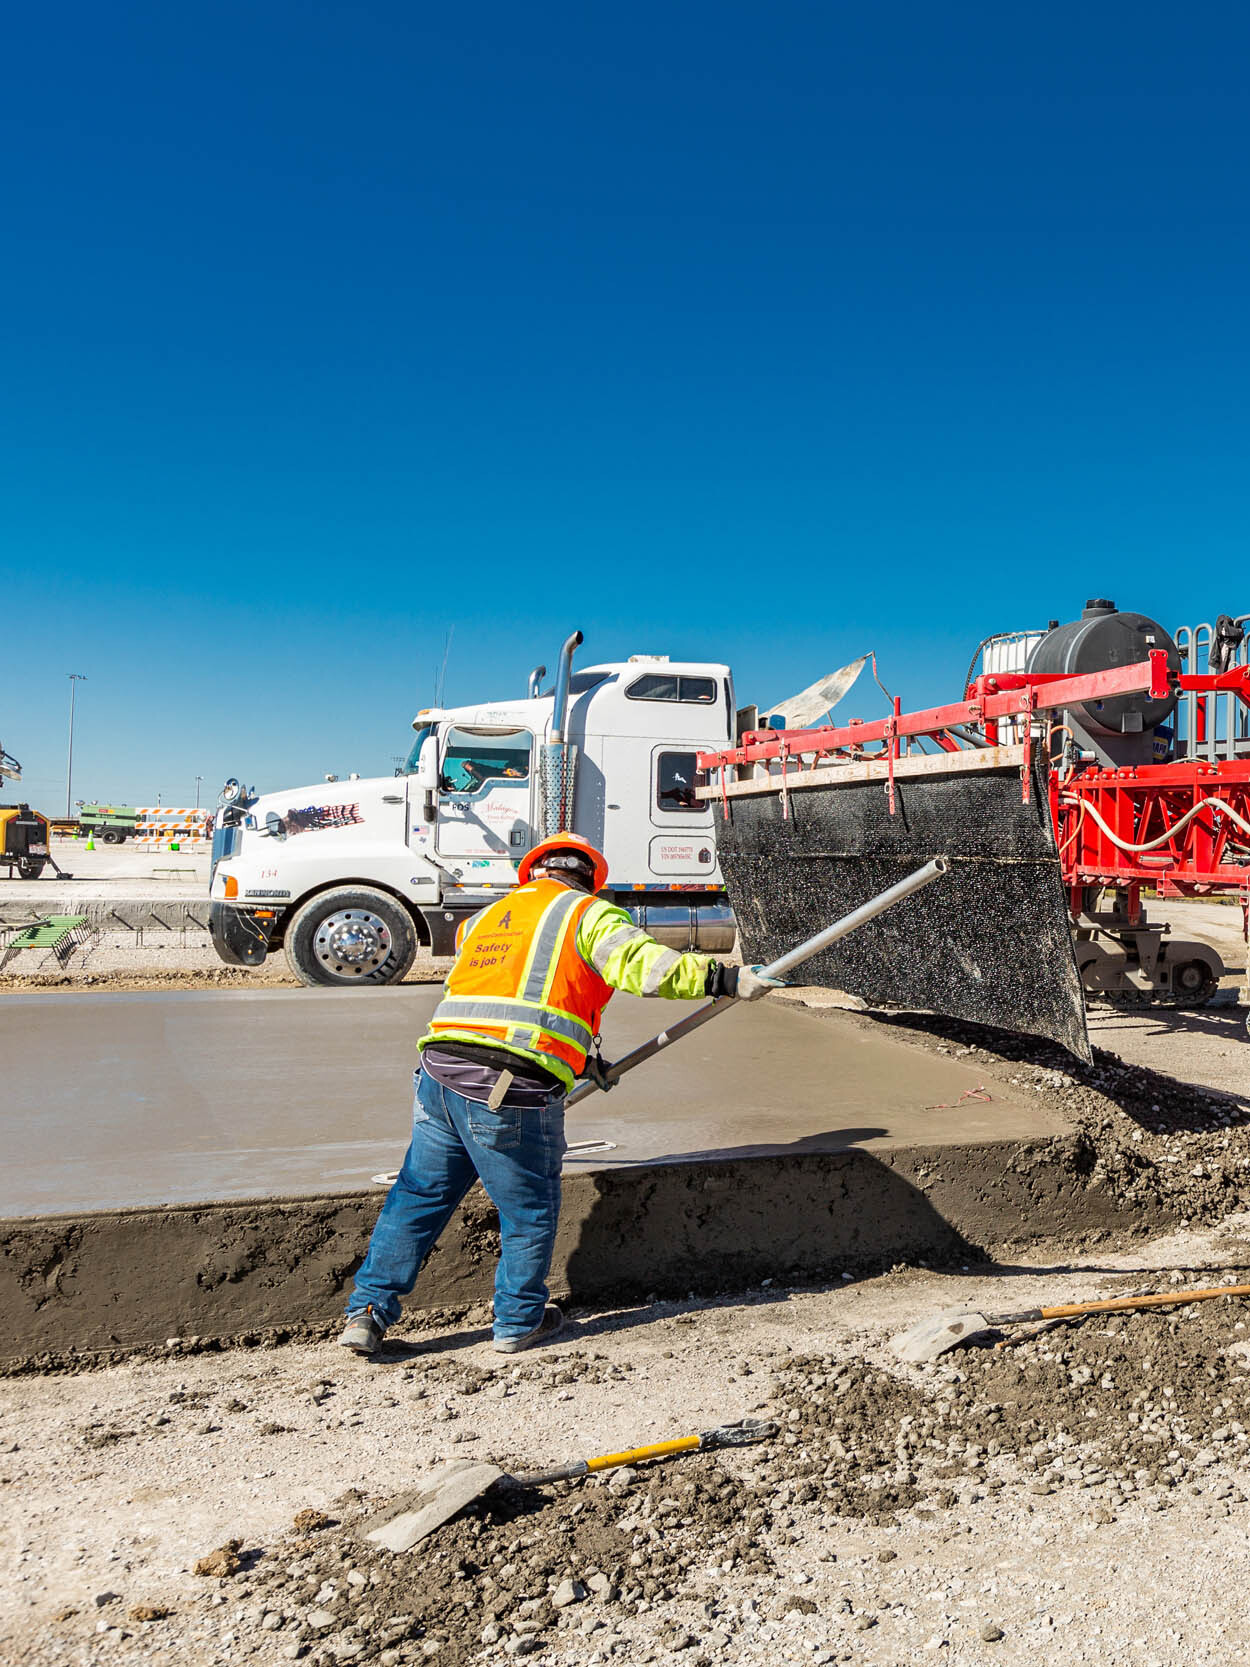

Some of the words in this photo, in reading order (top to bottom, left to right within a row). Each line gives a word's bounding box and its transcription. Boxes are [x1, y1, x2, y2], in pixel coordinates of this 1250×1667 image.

[474, 943, 513, 953] Safety
[469, 957, 479, 967] is
[480, 956, 497, 969] job
[500, 954, 506, 965] 1
